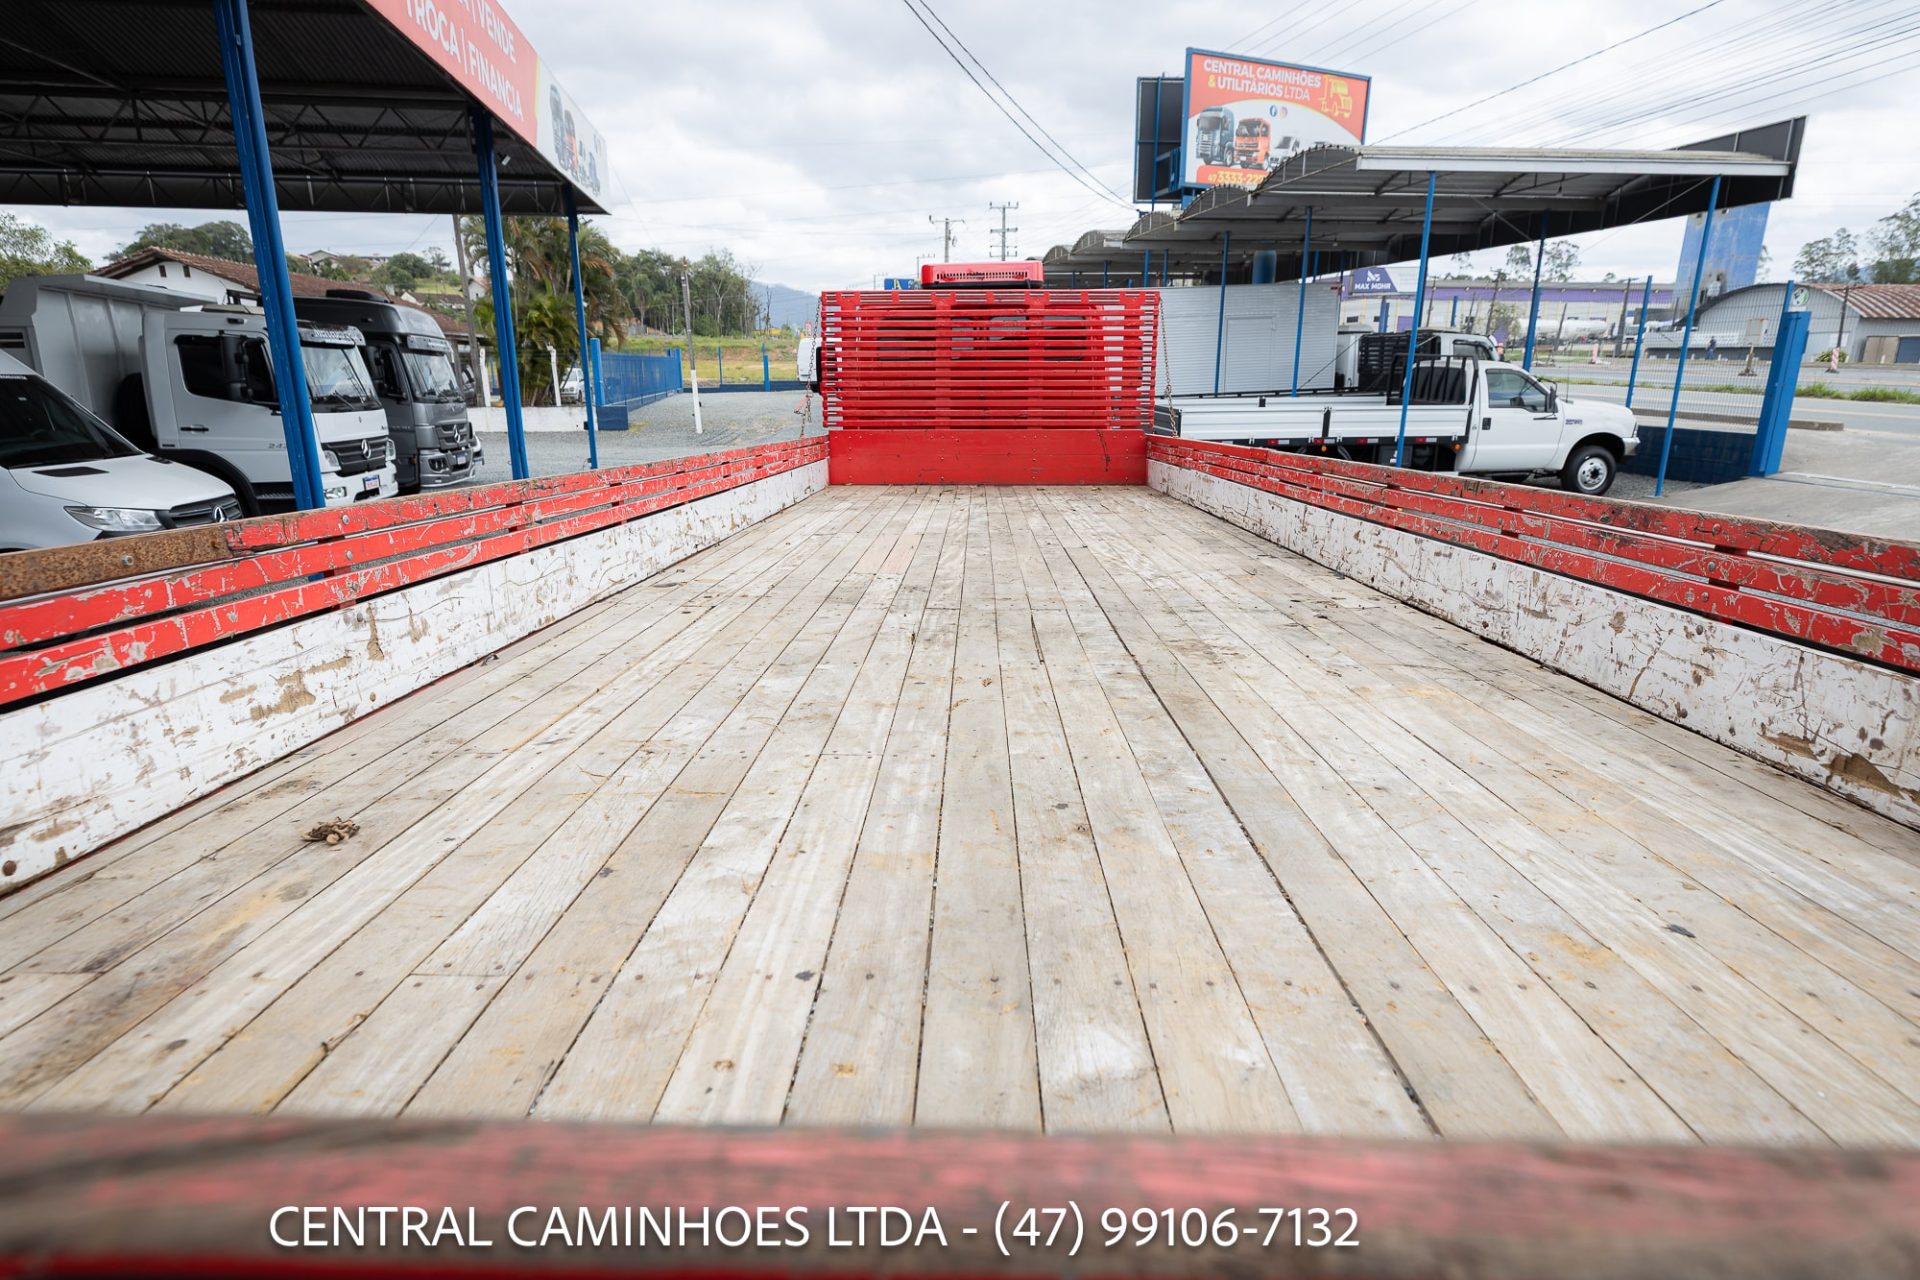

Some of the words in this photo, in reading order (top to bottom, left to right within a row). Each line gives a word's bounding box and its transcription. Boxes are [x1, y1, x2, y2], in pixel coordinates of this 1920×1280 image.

[477, 0, 517, 64] VENDE
[467, 40, 524, 121] FINANCIA
[1203, 59, 1255, 78] CENTRAL
[1256, 66, 1321, 88] CAMINHÕES
[1208, 74, 1216, 88] &
[1217, 76, 1284, 97] UTILITÁRIOS
[1284, 86, 1311, 101] LTDA
[1354, 282, 1370, 290] MAX
[1371, 282, 1392, 290] MOHR
